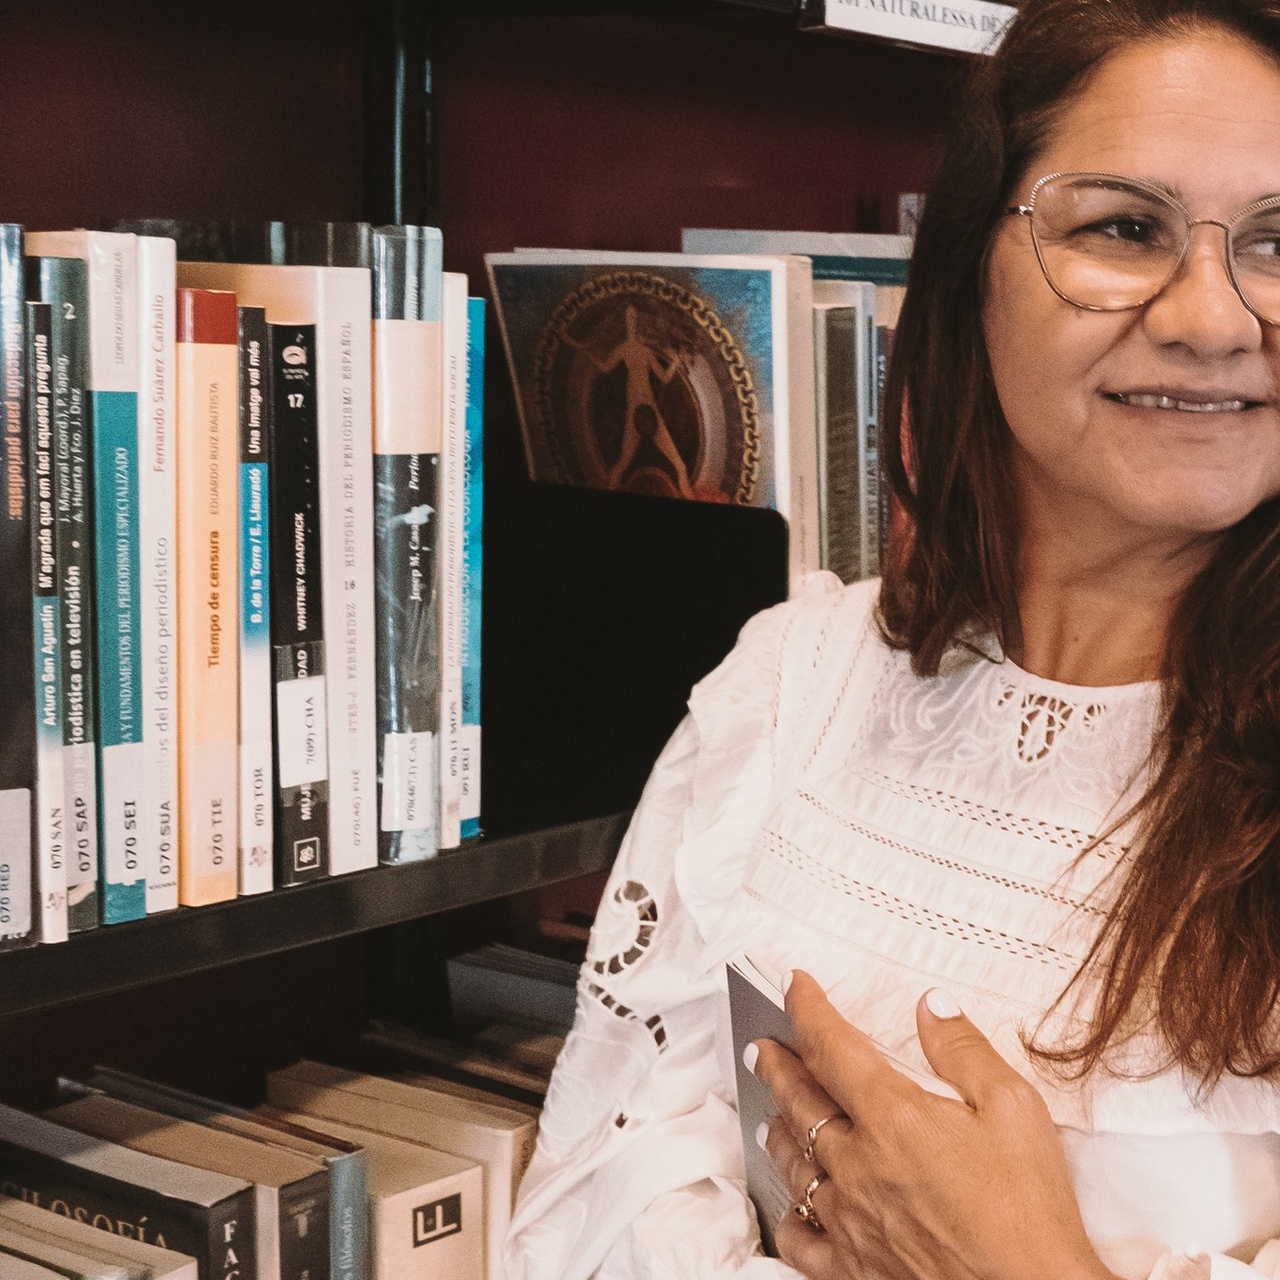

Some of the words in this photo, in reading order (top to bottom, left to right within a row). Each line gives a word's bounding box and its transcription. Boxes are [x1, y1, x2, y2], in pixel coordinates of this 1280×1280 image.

[64, 302, 77, 320] 2
[151, 294, 164, 353] Carballo
[35, 334, 52, 394] pregunta
[246, 340, 260, 366] més
[340, 321, 353, 380] ESPAÑOL
[151, 358, 165, 404] Suárez
[248, 368, 260, 386] val
[4, 401, 21, 433] para
[208, 382, 219, 433] BAUTISTA
[287, 393, 305, 409] 17
[37, 396, 53, 448] aquesta
[342, 386, 354, 468] PERIODISMO
[152, 408, 165, 473] Fernando
[209, 436, 219, 460] RUIZ
[248, 430, 261, 454] Una
[4, 437, 23, 521] periodistas:
[39, 478, 51, 498] em
[56, 462, 71, 511] Mayoral
[70, 466, 83, 507] Huerta
[209, 463, 219, 515] EDUARDO
[248, 468, 262, 521] Llauradó
[343, 474, 354, 499] DEL
[39, 501, 54, 526] que
[294, 512, 306, 575] CHADWICK
[344, 506, 355, 567] HISTORIA
[39, 529, 54, 588] M'agrada
[116, 538, 132, 608] PERIODISMO
[207, 530, 220, 588] censura
[250, 545, 262, 576] Torre
[152, 537, 173, 639] periodístico
[207, 592, 220, 610] de
[250, 579, 262, 590] la
[250, 593, 262, 608] de
[408, 567, 425, 602] Josep
[66, 566, 82, 646] televisión
[118, 610, 132, 632] DEL
[295, 577, 308, 632] WHITNEY
[39, 604, 57, 654] Agustín
[207, 615, 222, 668] Tiempo
[40, 657, 56, 682] San
[68, 649, 83, 669] en
[153, 644, 170, 701] diseño
[118, 634, 133, 720] FUNDAMENTOS
[41, 685, 57, 726] Arturo
[154, 707, 170, 732] del
[303, 696, 316, 728] CHA
[304, 732, 317, 765] 7(09)
[253, 767, 265, 799] TOR
[48, 807, 63, 840] SAN
[74, 796, 89, 832] SAP
[123, 800, 138, 830] SEI
[158, 800, 172, 837] SUA
[210, 798, 223, 828] TIE
[254, 803, 266, 827] 070
[49, 844, 63, 870] 070
[77, 838, 91, 872] 070
[124, 836, 138, 870] 070
[158, 841, 172, 875] 070
[211, 833, 224, 865] 070
[0, 864, 10, 891] RED
